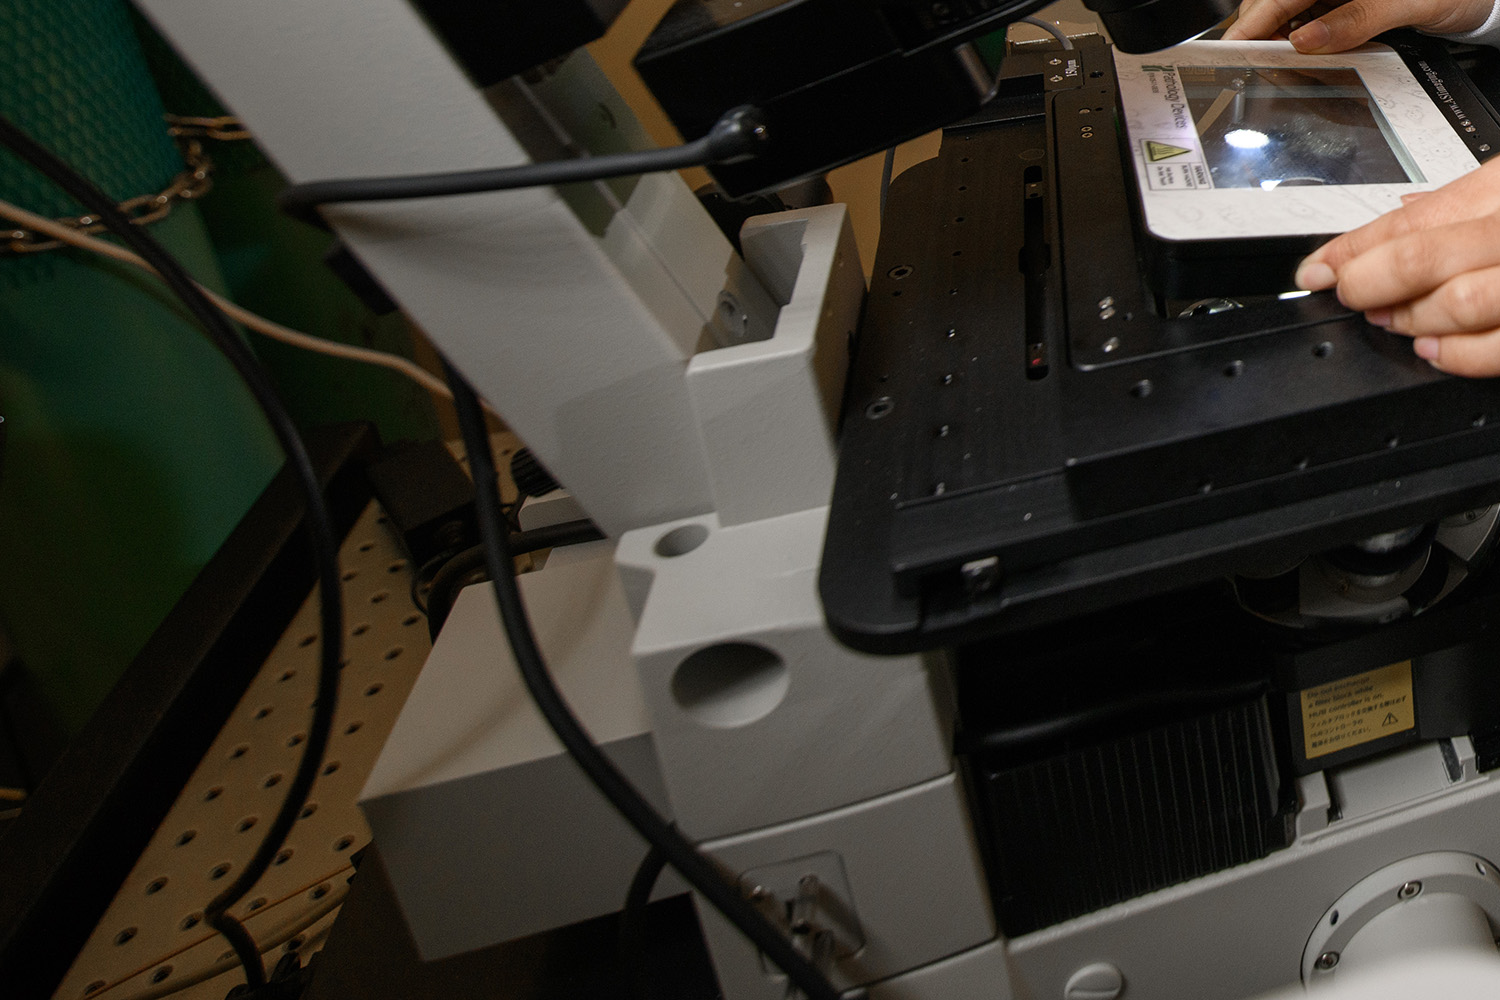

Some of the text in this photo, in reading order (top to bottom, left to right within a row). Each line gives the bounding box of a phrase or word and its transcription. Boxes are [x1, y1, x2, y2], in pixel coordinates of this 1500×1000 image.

[1163, 73, 1187, 129] Pathology Devices
[1328, 699, 1363, 713] controller
